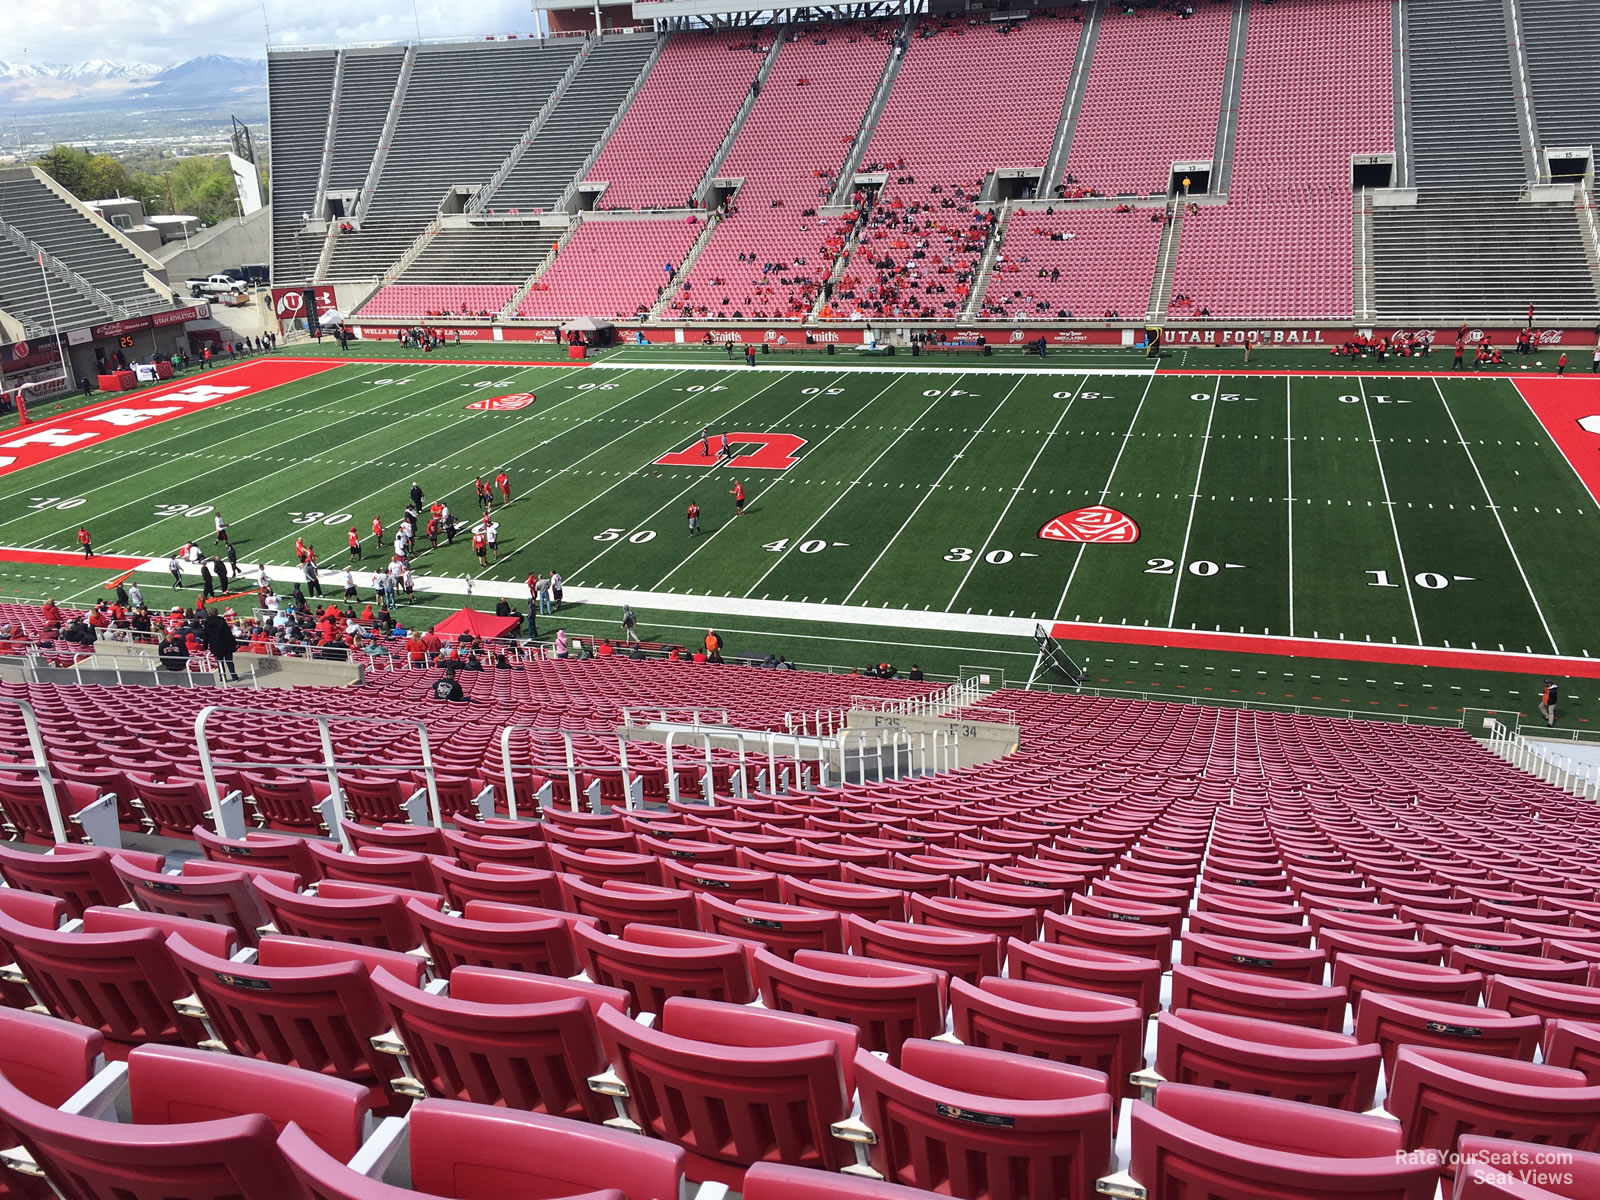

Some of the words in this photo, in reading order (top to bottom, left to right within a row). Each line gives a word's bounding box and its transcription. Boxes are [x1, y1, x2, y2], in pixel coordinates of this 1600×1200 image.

[1369, 157, 1378, 165] 14
[154, 316, 169, 325] UTAH
[170, 311, 196, 322] ATHLETICS
[121, 336, 134, 348] 25
[710, 330, 742, 342] Smith's
[1165, 331, 1215, 343] UTAH
[801, 387, 846, 395] 50
[922, 389, 969, 397] 40
[1052, 391, 1101, 399] 30
[1190, 393, 1241, 401] 20
[1338, 395, 1392, 404] 10
[0, 385, 251, 468] TAH
[153, 504, 215, 518] 20
[291, 512, 353, 526] 30
[592, 528, 657, 544] 50
[762, 538, 828, 554] 40
[943, 547, 1014, 564] 30
[1144, 558, 1220, 577] 20
[1364, 570, 1449, 589] 10
[962, 725, 976, 737] 34
